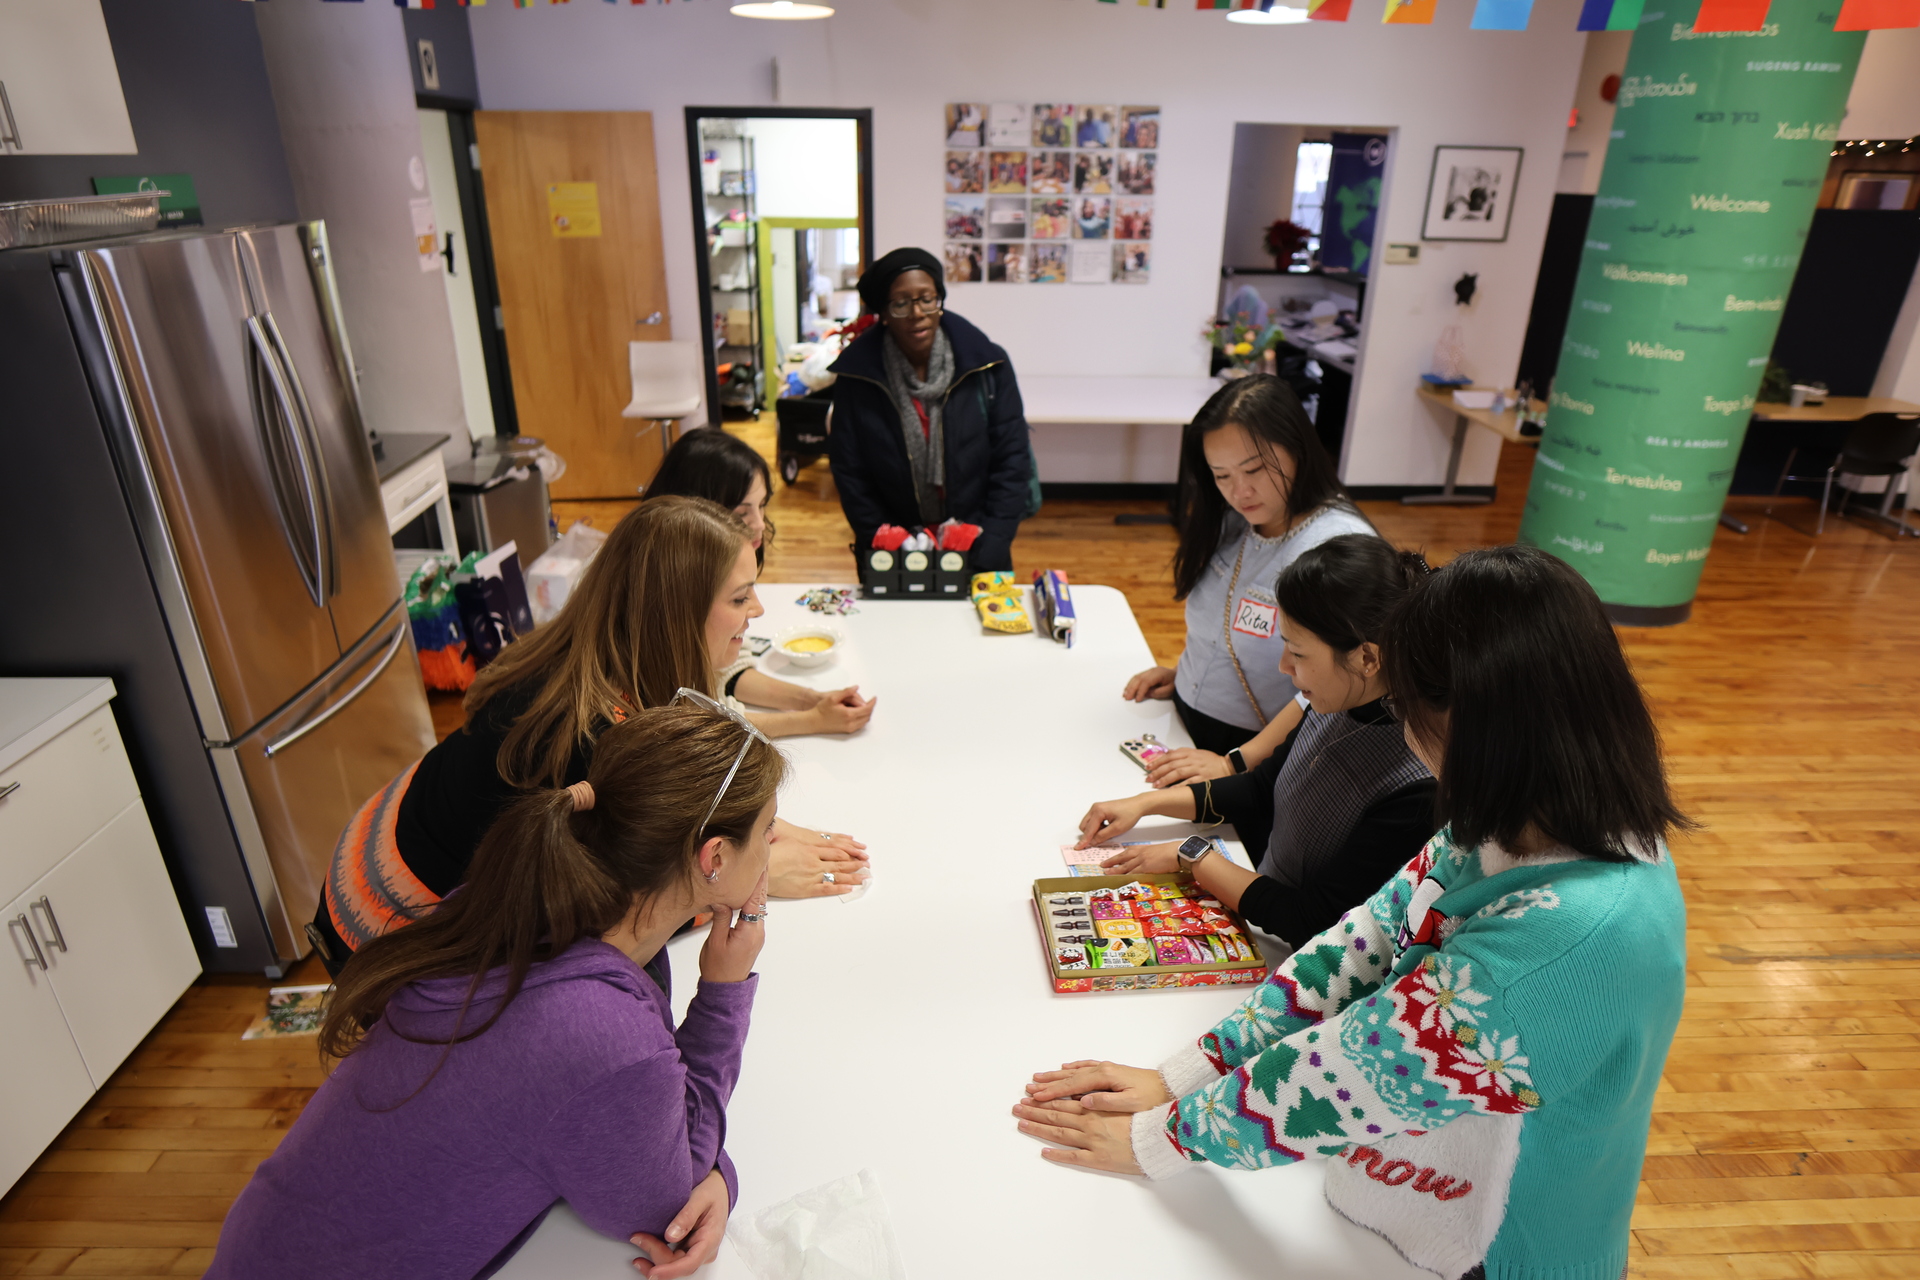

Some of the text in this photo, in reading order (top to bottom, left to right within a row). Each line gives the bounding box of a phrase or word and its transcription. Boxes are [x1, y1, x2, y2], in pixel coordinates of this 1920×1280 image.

[1690, 193, 1770, 213] Welcome
[1626, 339, 1685, 361] Welina
[1605, 467, 1682, 491] Tervetuloa
[1238, 605, 1268, 632] Rita
[1347, 1146, 1473, 1201] now
